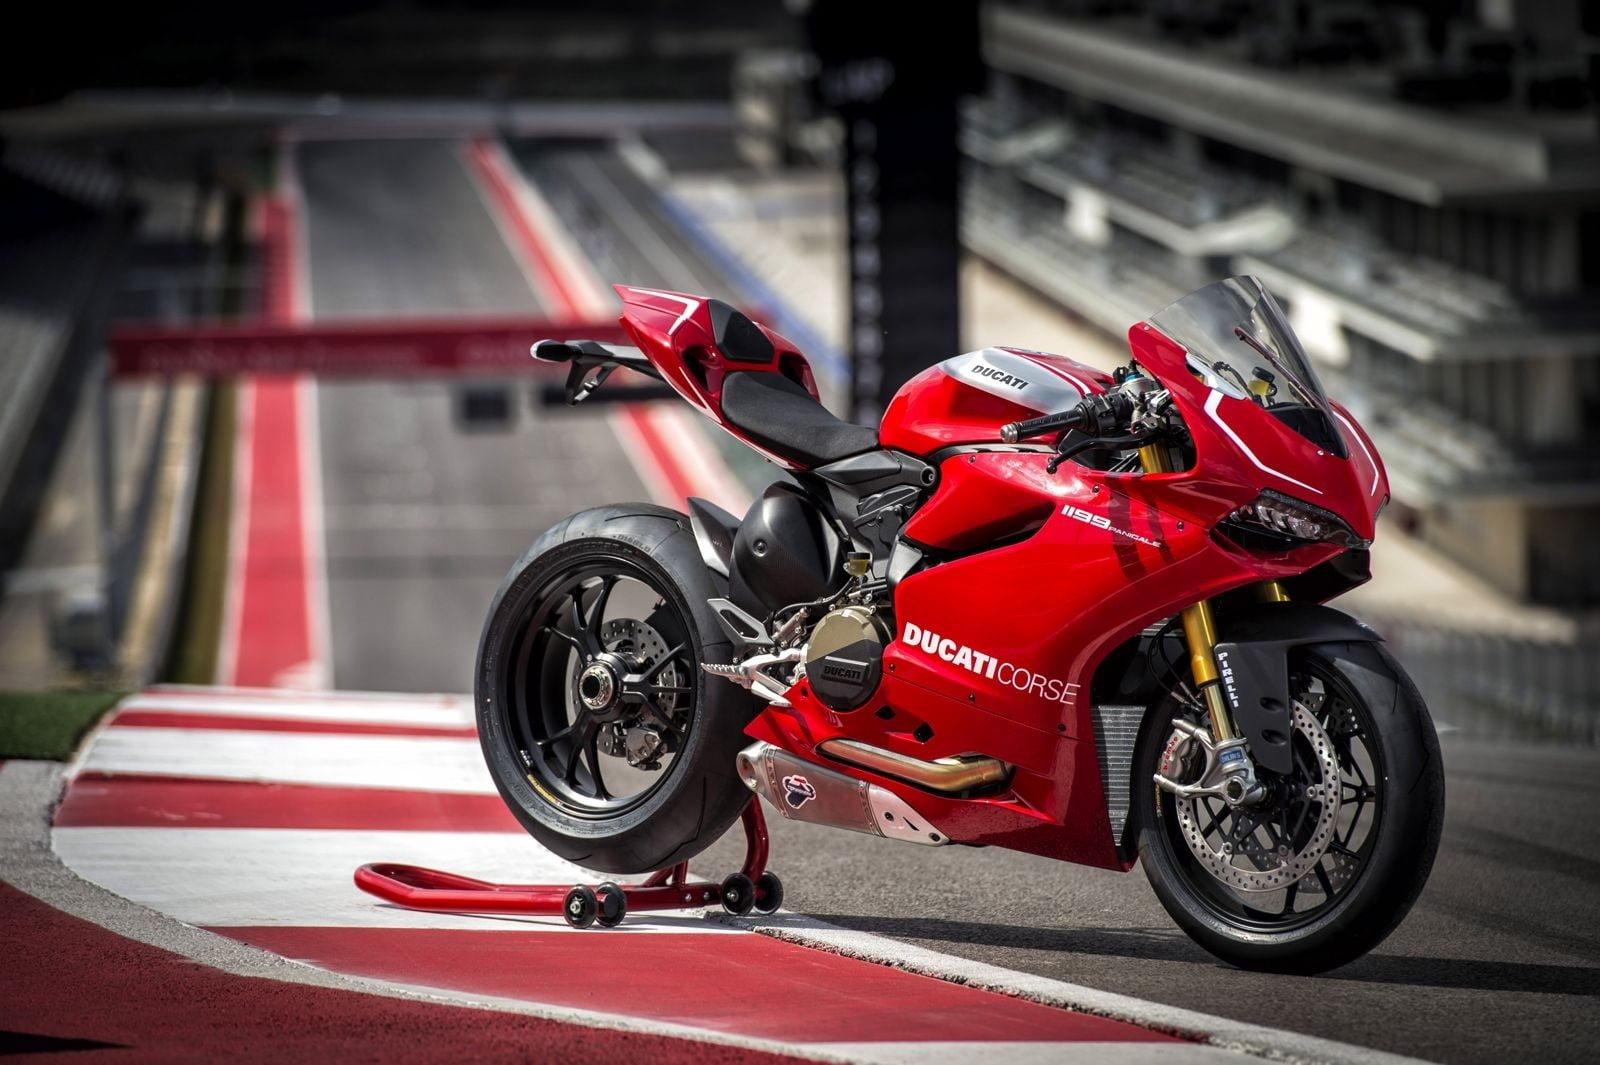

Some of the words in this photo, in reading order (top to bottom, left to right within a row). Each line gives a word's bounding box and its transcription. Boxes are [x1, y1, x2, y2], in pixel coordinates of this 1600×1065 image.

[972, 365, 1029, 390] DUCATI
[1061, 504, 1112, 530] 1199
[1108, 526, 1162, 548] PANIGALE
[824, 665, 862, 680] DUCATI
[902, 621, 998, 680] DUCATI
[997, 662, 1081, 705] CORSE
[1218, 651, 1239, 708] PIRELLI
